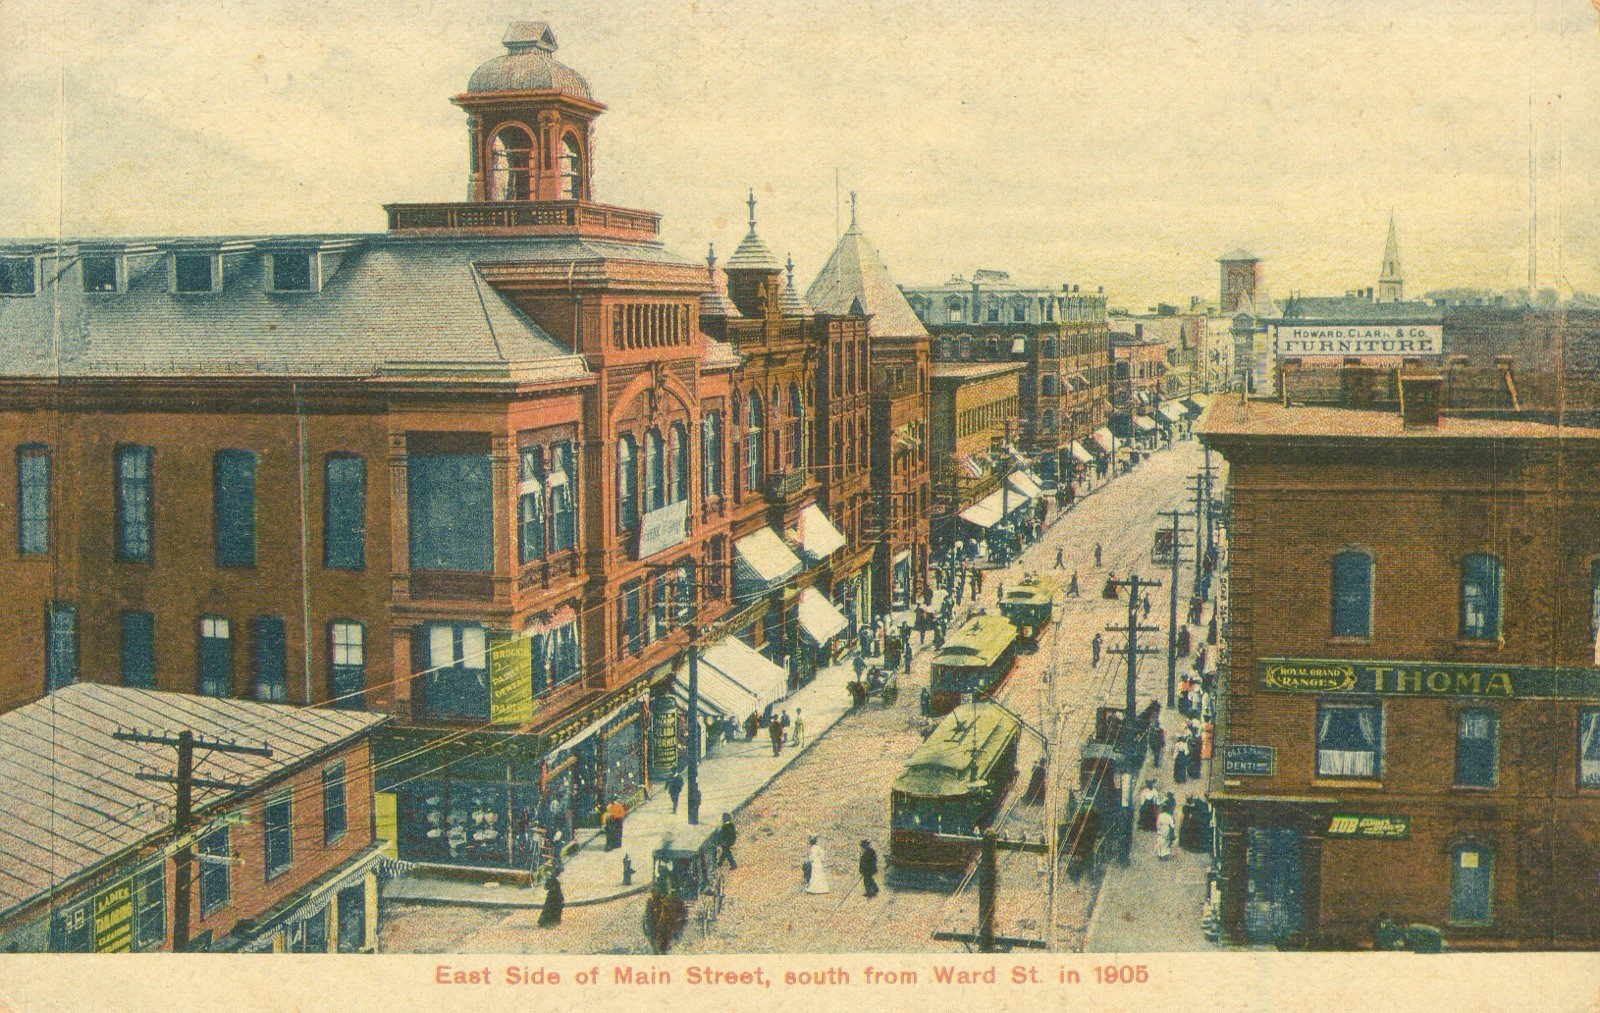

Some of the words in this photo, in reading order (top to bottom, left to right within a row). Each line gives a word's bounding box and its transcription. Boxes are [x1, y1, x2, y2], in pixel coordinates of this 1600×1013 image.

[1395, 328, 1404, 338] &
[1285, 340, 1433, 351] FURNITURE
[1309, 668, 1341, 676] GRAND
[1282, 677, 1338, 687] RANGES
[98, 887, 130, 912] LADIES
